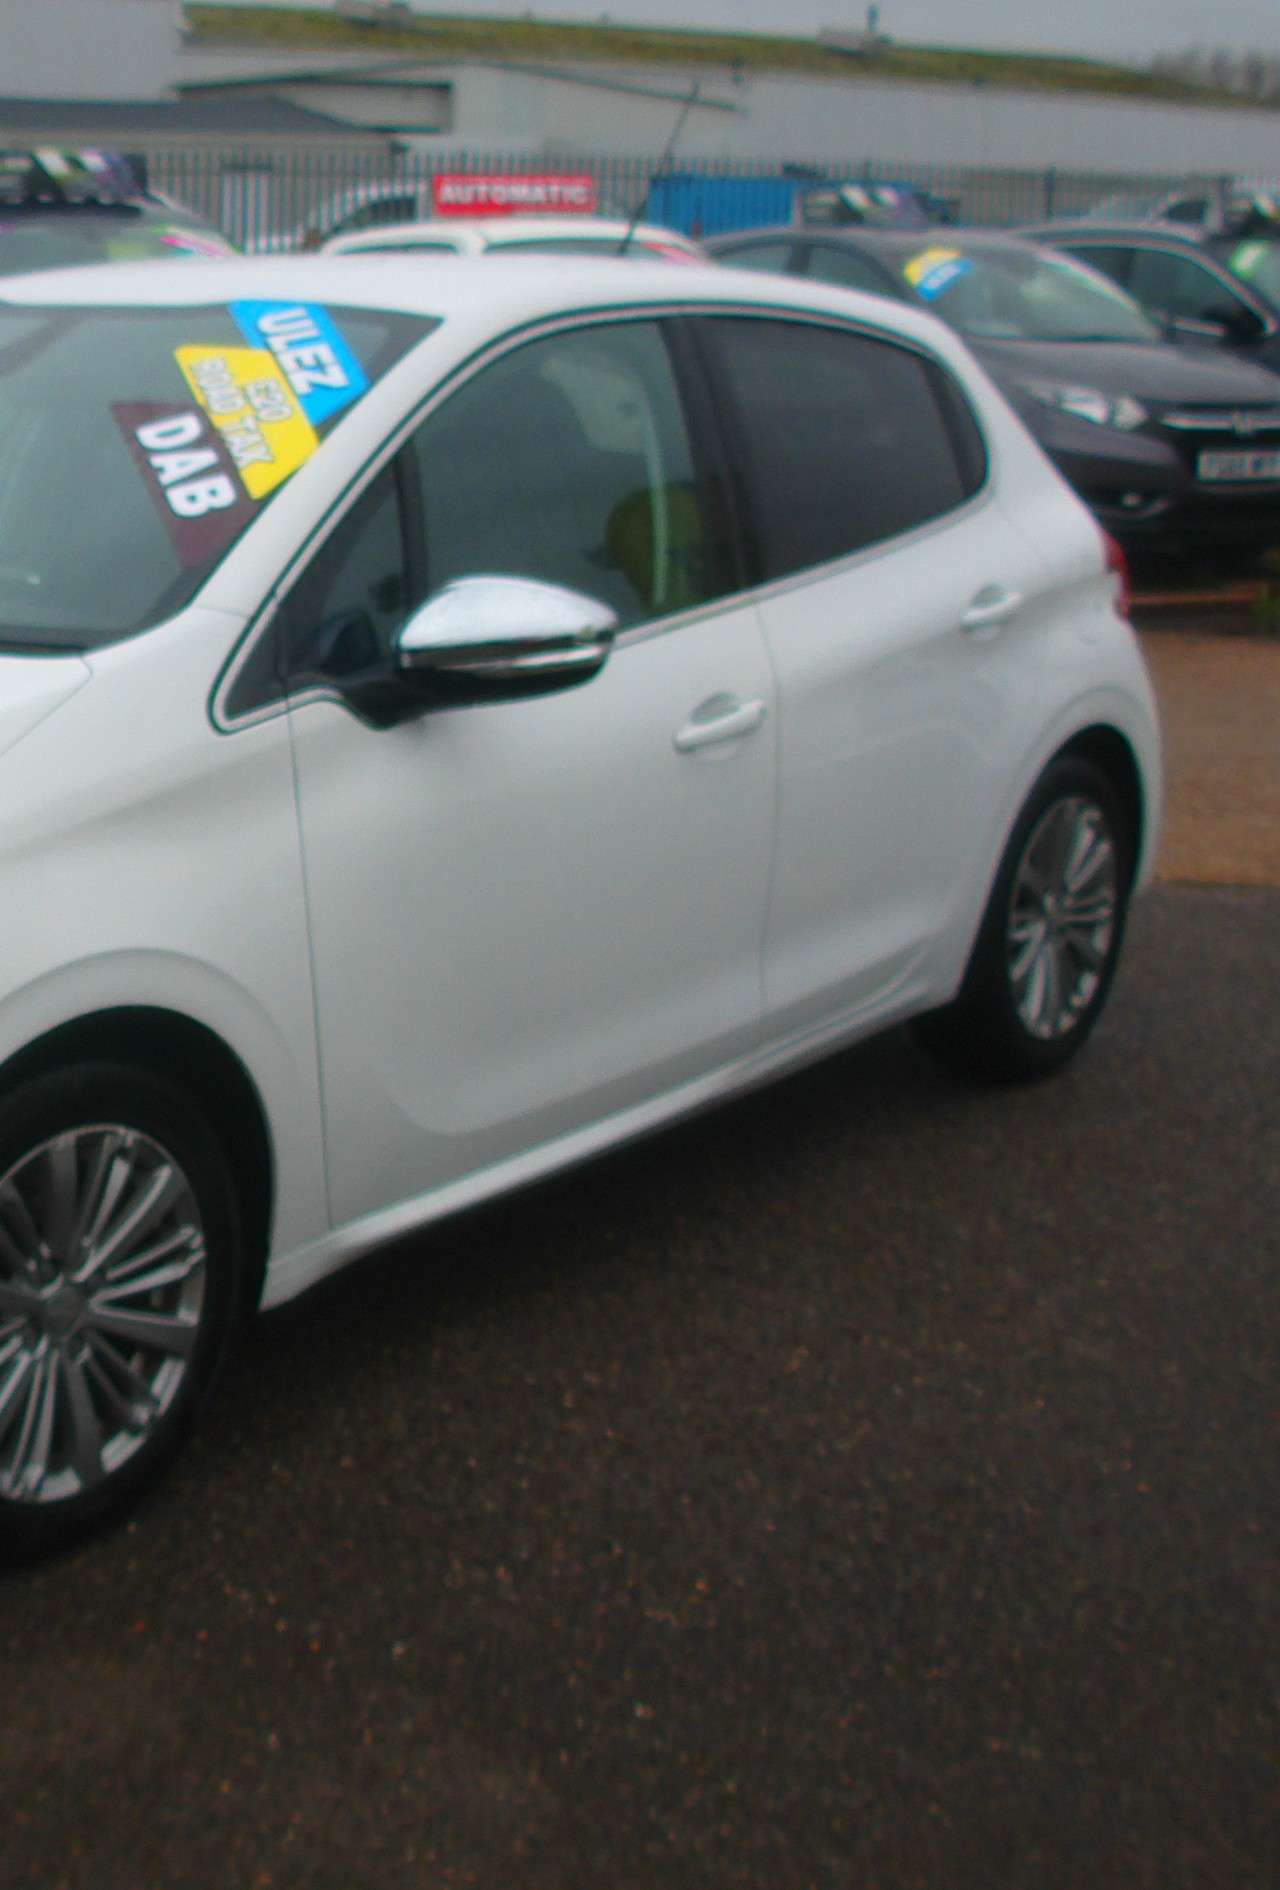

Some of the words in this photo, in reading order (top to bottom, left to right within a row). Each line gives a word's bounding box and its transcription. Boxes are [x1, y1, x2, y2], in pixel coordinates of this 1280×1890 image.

[440, 182, 590, 204] AUTOMATIC
[256, 306, 350, 396] ULEZ
[190, 356, 245, 414] ROAD
[221, 414, 275, 471] TAX
[135, 411, 237, 519] DAB
